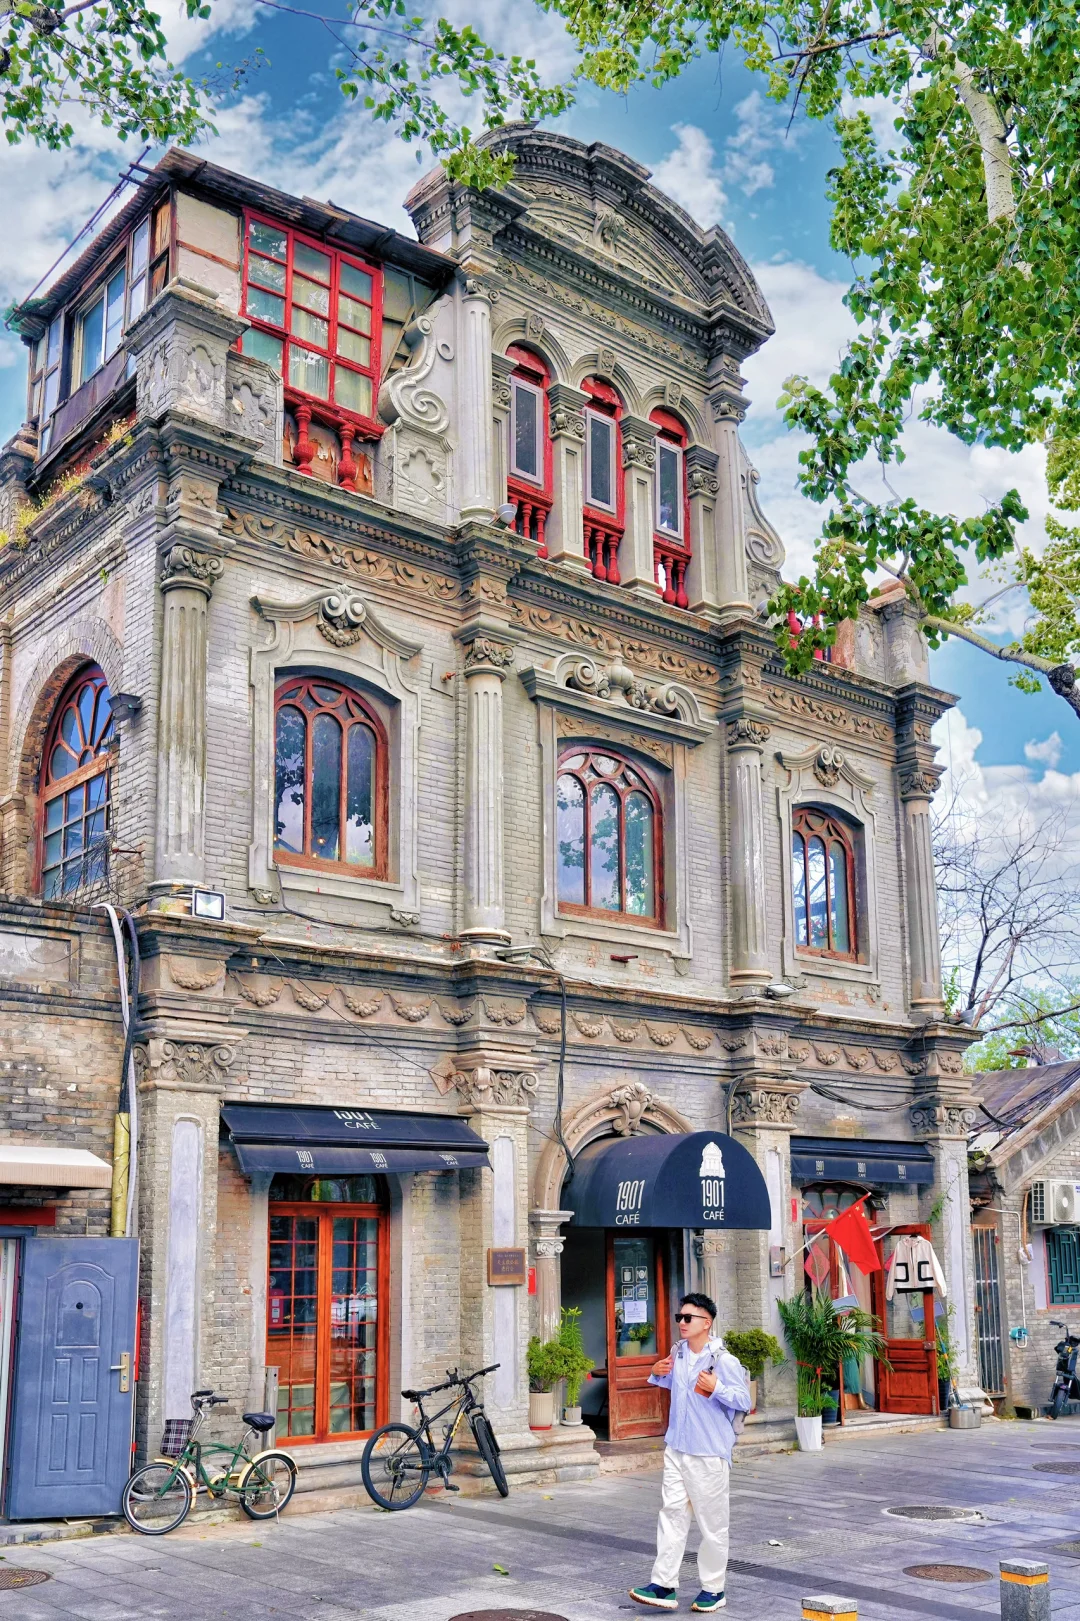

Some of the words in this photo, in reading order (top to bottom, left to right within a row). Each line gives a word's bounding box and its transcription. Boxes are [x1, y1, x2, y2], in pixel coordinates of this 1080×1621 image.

[296, 1151, 313, 1162] 1901
[370, 1153, 386, 1162] 1901
[616, 1180, 645, 1211] 1901
[701, 1179, 725, 1207] 1901
[615, 1211, 640, 1225] CAFÉ
[703, 1210, 725, 1221] CAFÉ
